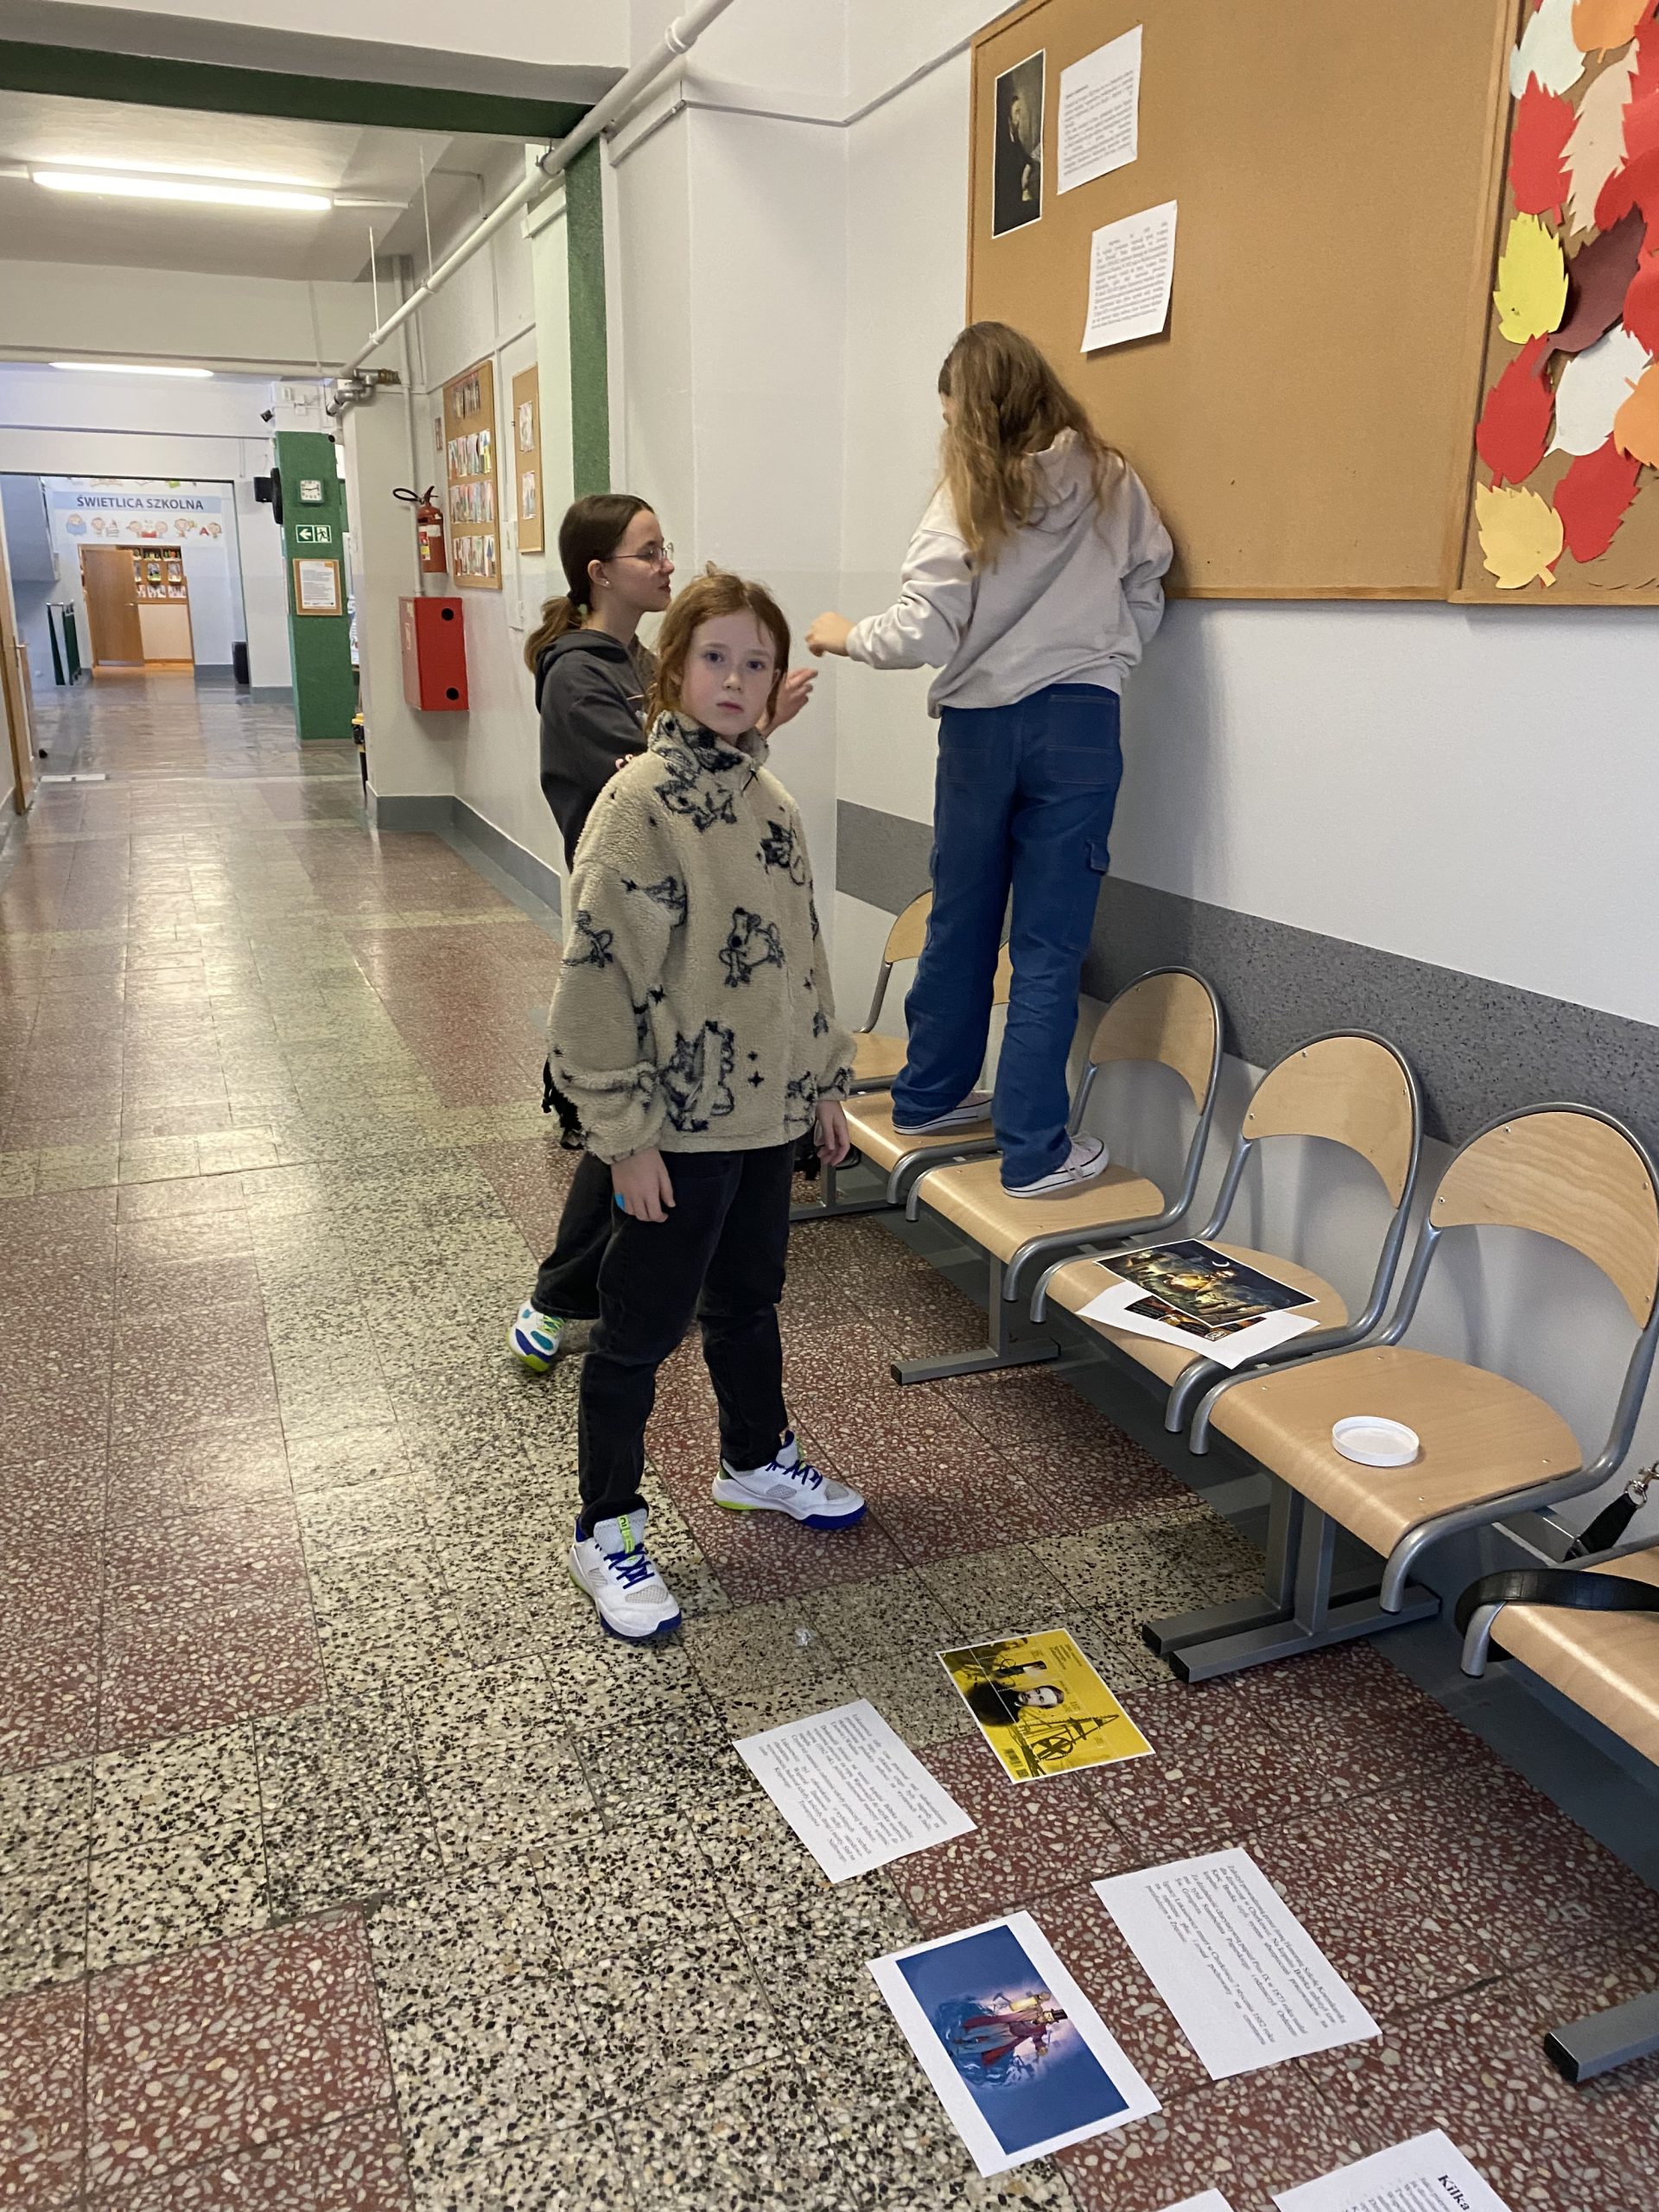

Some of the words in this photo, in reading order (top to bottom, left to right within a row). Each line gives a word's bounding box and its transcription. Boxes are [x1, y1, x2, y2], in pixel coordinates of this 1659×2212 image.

[77, 497, 143, 508] ŚWIETLICA
[146, 499, 204, 510] SZKOLNA
[1437, 2174, 1471, 2211] Kilka
